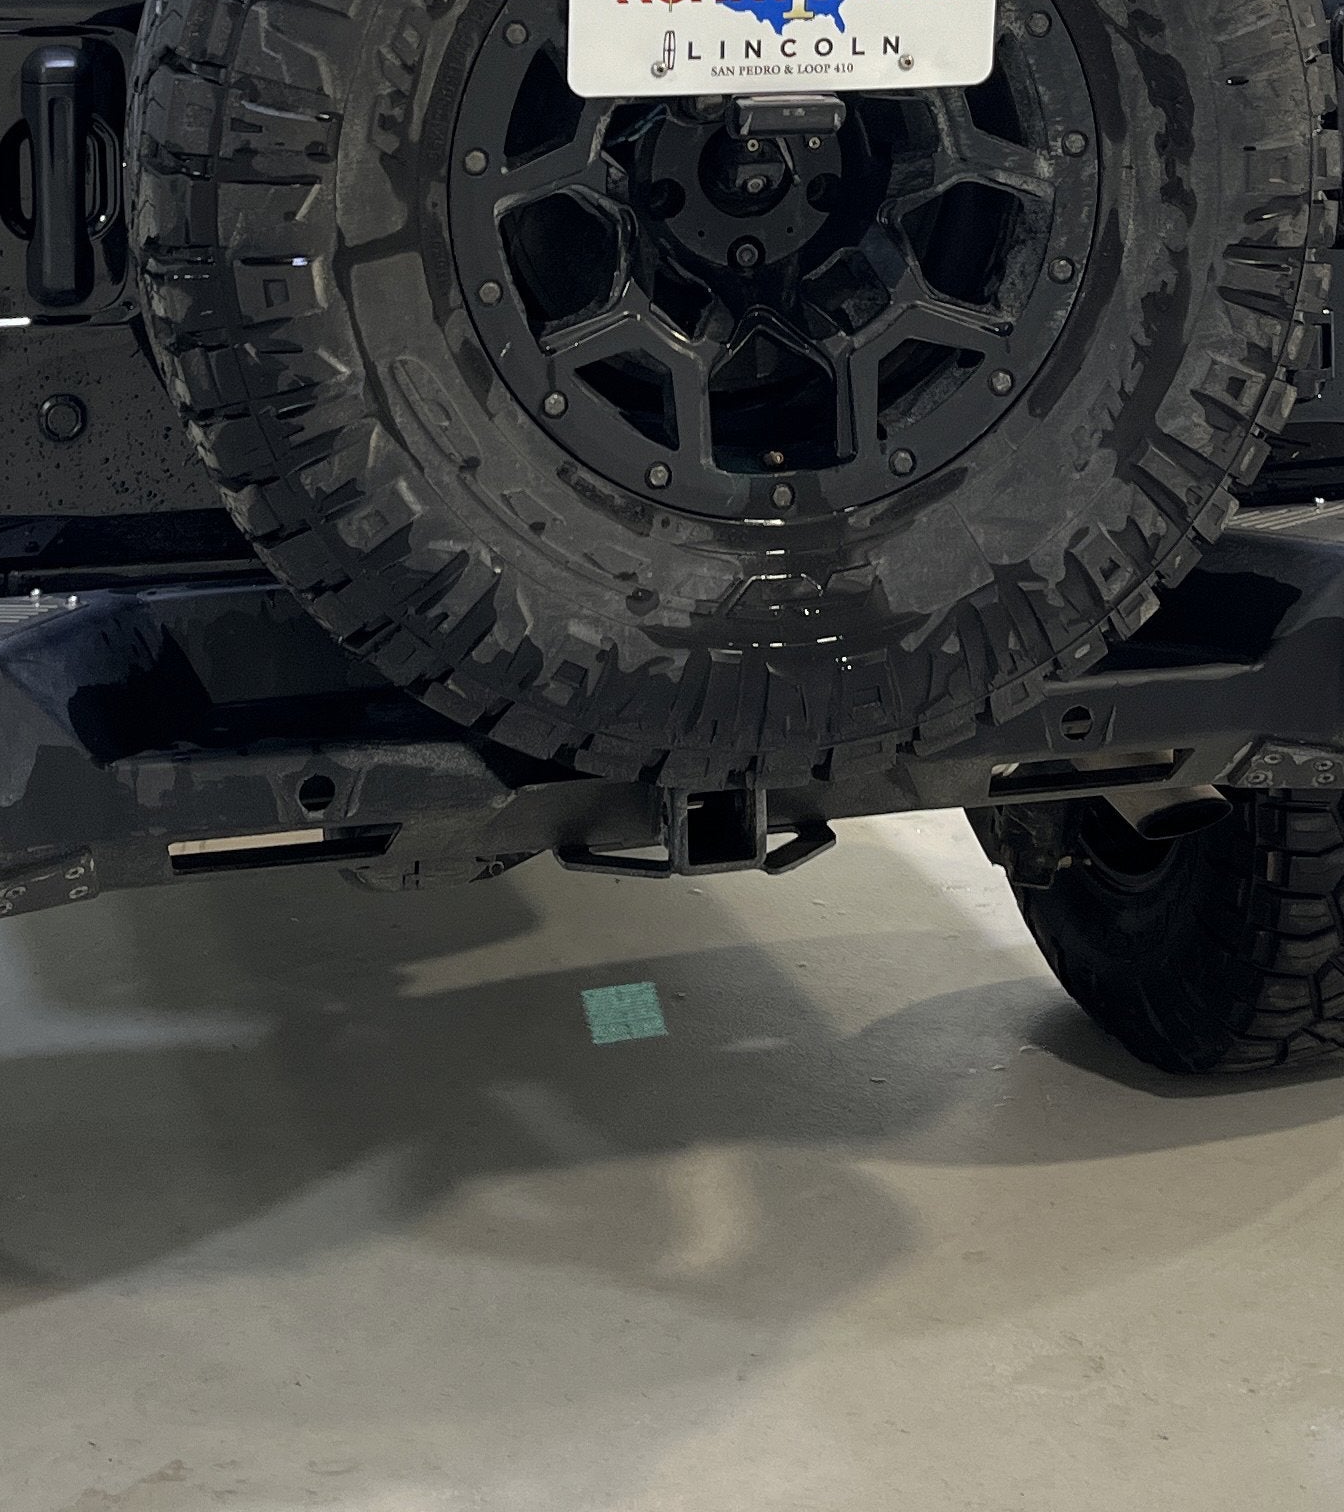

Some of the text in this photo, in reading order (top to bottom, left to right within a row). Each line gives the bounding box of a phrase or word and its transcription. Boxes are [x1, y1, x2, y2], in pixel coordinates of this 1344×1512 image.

[687, 35, 900, 60] LINCOLN
[711, 62, 854, 77] SAN PEDRO & LOOP 410
